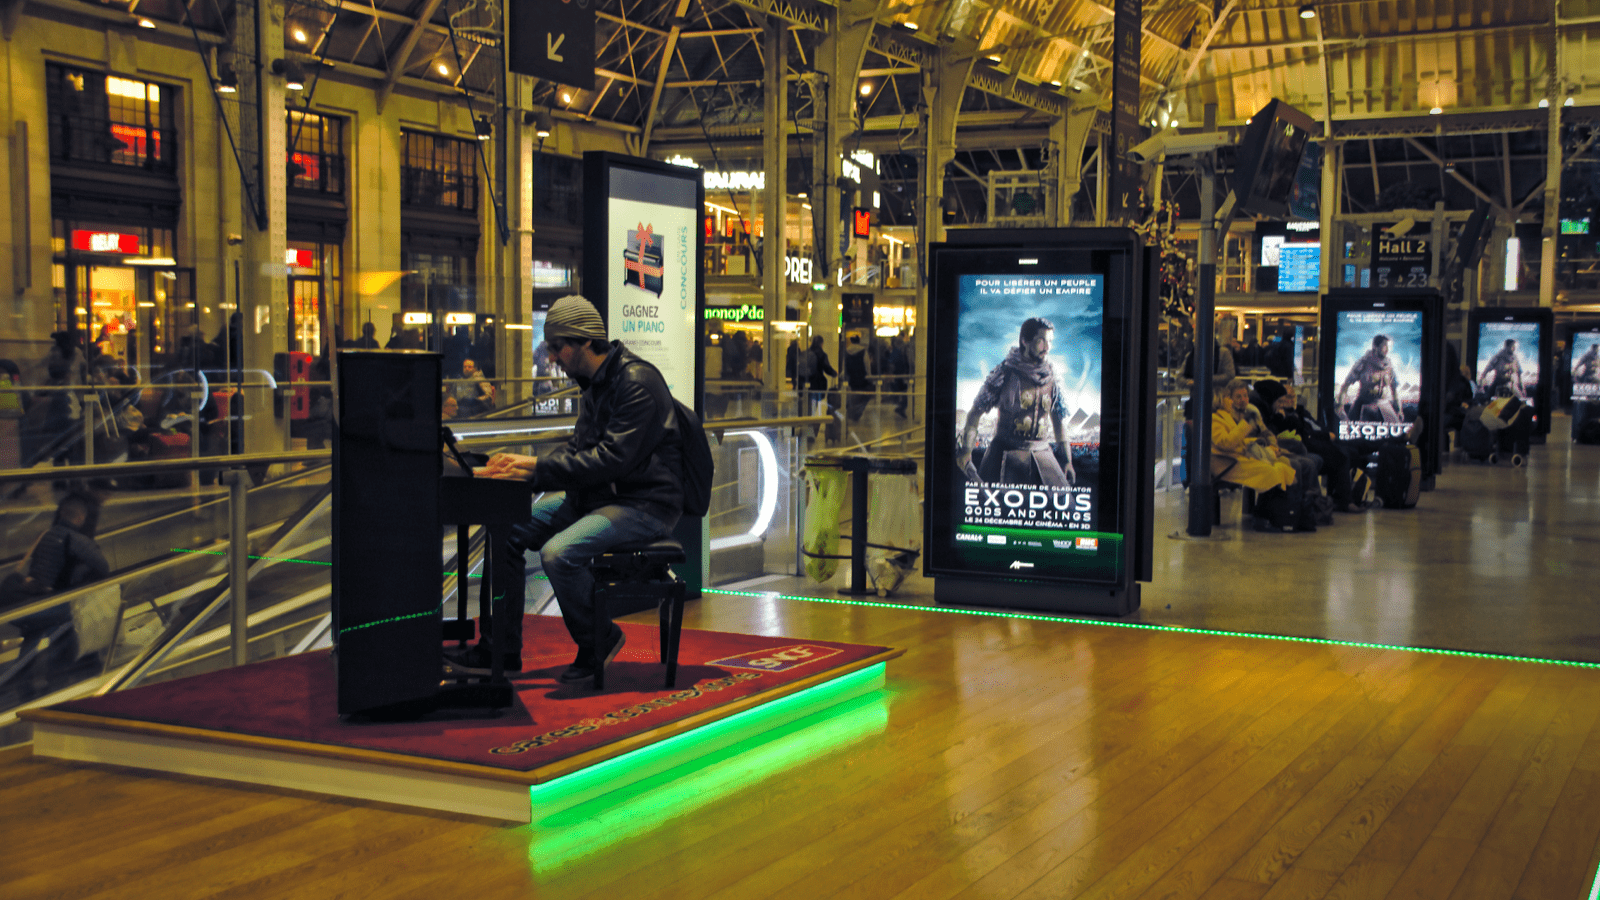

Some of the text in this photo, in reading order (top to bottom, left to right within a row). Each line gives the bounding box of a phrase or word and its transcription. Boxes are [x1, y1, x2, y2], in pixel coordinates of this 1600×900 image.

[1379, 240, 1426, 253] Hall 2
[680, 226, 688, 310] CONCOURS
[975, 278, 1097, 287] POUR LIBÉRER UN PEUPLE
[1378, 273, 1428, 288] 5 23
[1003, 286, 1036, 295] DÉFIER
[1055, 287, 1091, 295] EMPIRE
[622, 304, 659, 318] GAGNEZ
[622, 320, 665, 333] UN PIANO
[991, 482, 1037, 491] RÉALISATEUR
[1051, 485, 1092, 493] GLADIATOR
[964, 488, 1092, 512] EXODUS
[965, 506, 1091, 522] GODS AND KINGS
[983, 516, 1023, 526] DÉCEMBRE
[1035, 519, 1063, 528] CINÉMA
[956, 533, 984, 542] CANAL+
